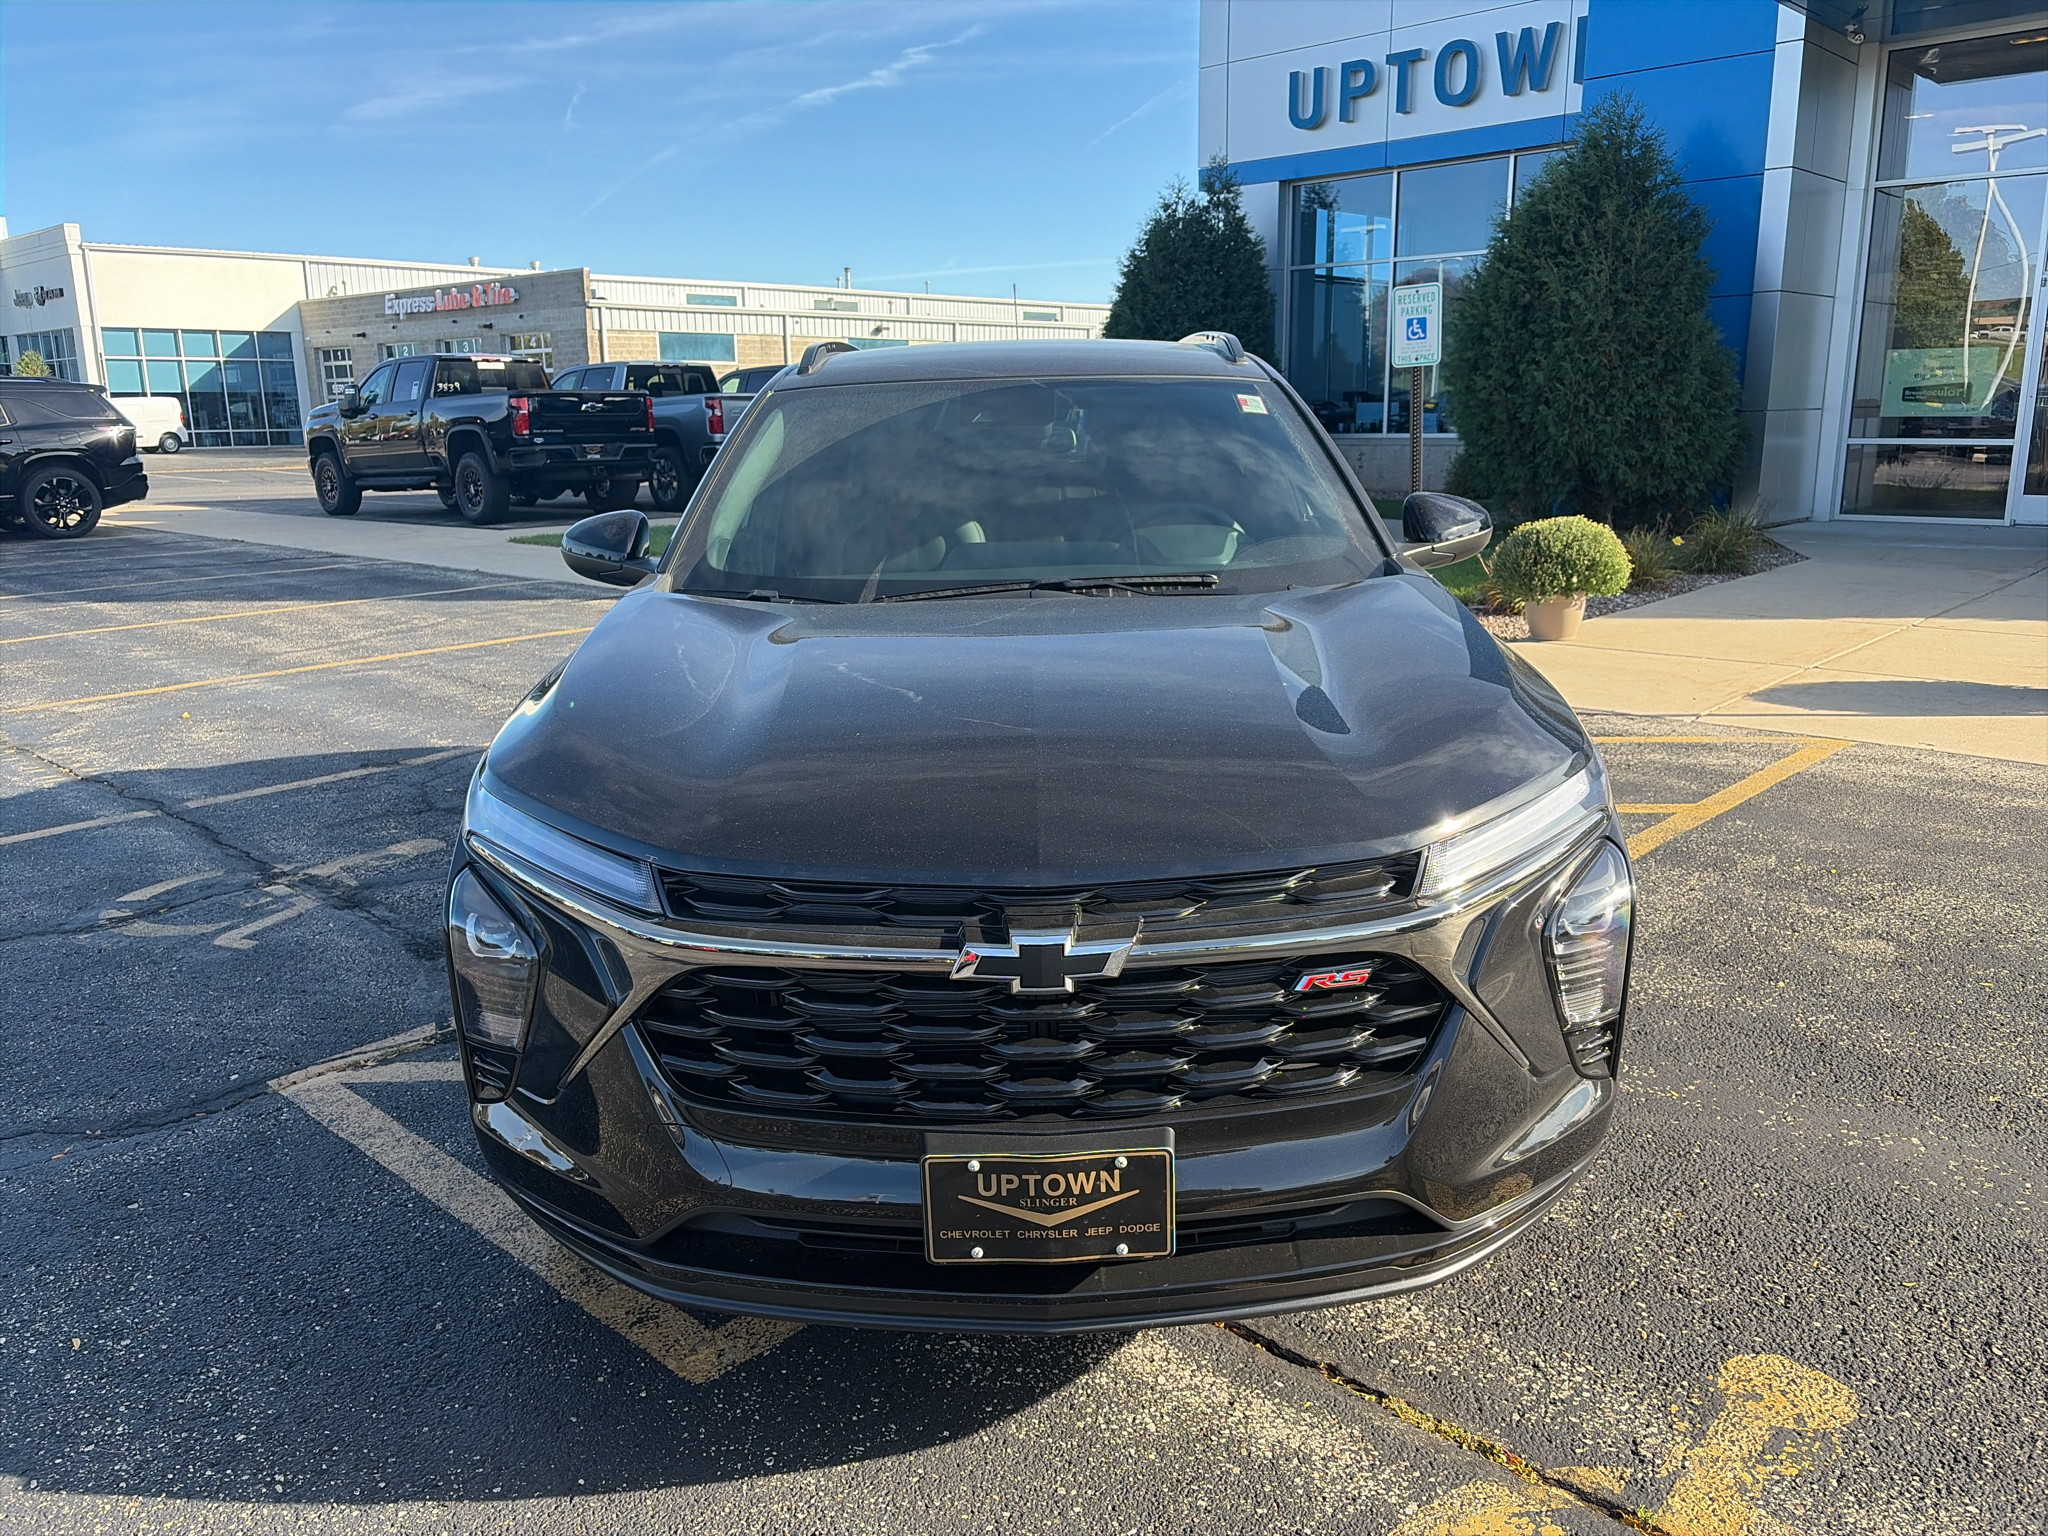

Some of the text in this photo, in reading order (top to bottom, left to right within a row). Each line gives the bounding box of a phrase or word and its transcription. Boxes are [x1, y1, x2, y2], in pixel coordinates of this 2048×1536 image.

[1288, 14, 1588, 130] UPTOW
[385, 283, 515, 319] Express Lube & Tire
[1397, 291, 1436, 305] RESERVED
[1400, 304, 1433, 317] PARKING
[462, 341, 469, 353] 3
[529, 337, 536, 348] 4
[337, 350, 342, 360] 1
[402, 346, 409, 356] 2
[1397, 355, 1412, 364] THIS
[437, 381, 460, 392] 3839
[1294, 967, 1373, 991] RS
[977, 1169, 1121, 1197] UPTOWN
[1019, 1197, 1078, 1208] SLINGER
[939, 1223, 1161, 1239] CHEVROLET CHRYSLER JEEP DODGE
